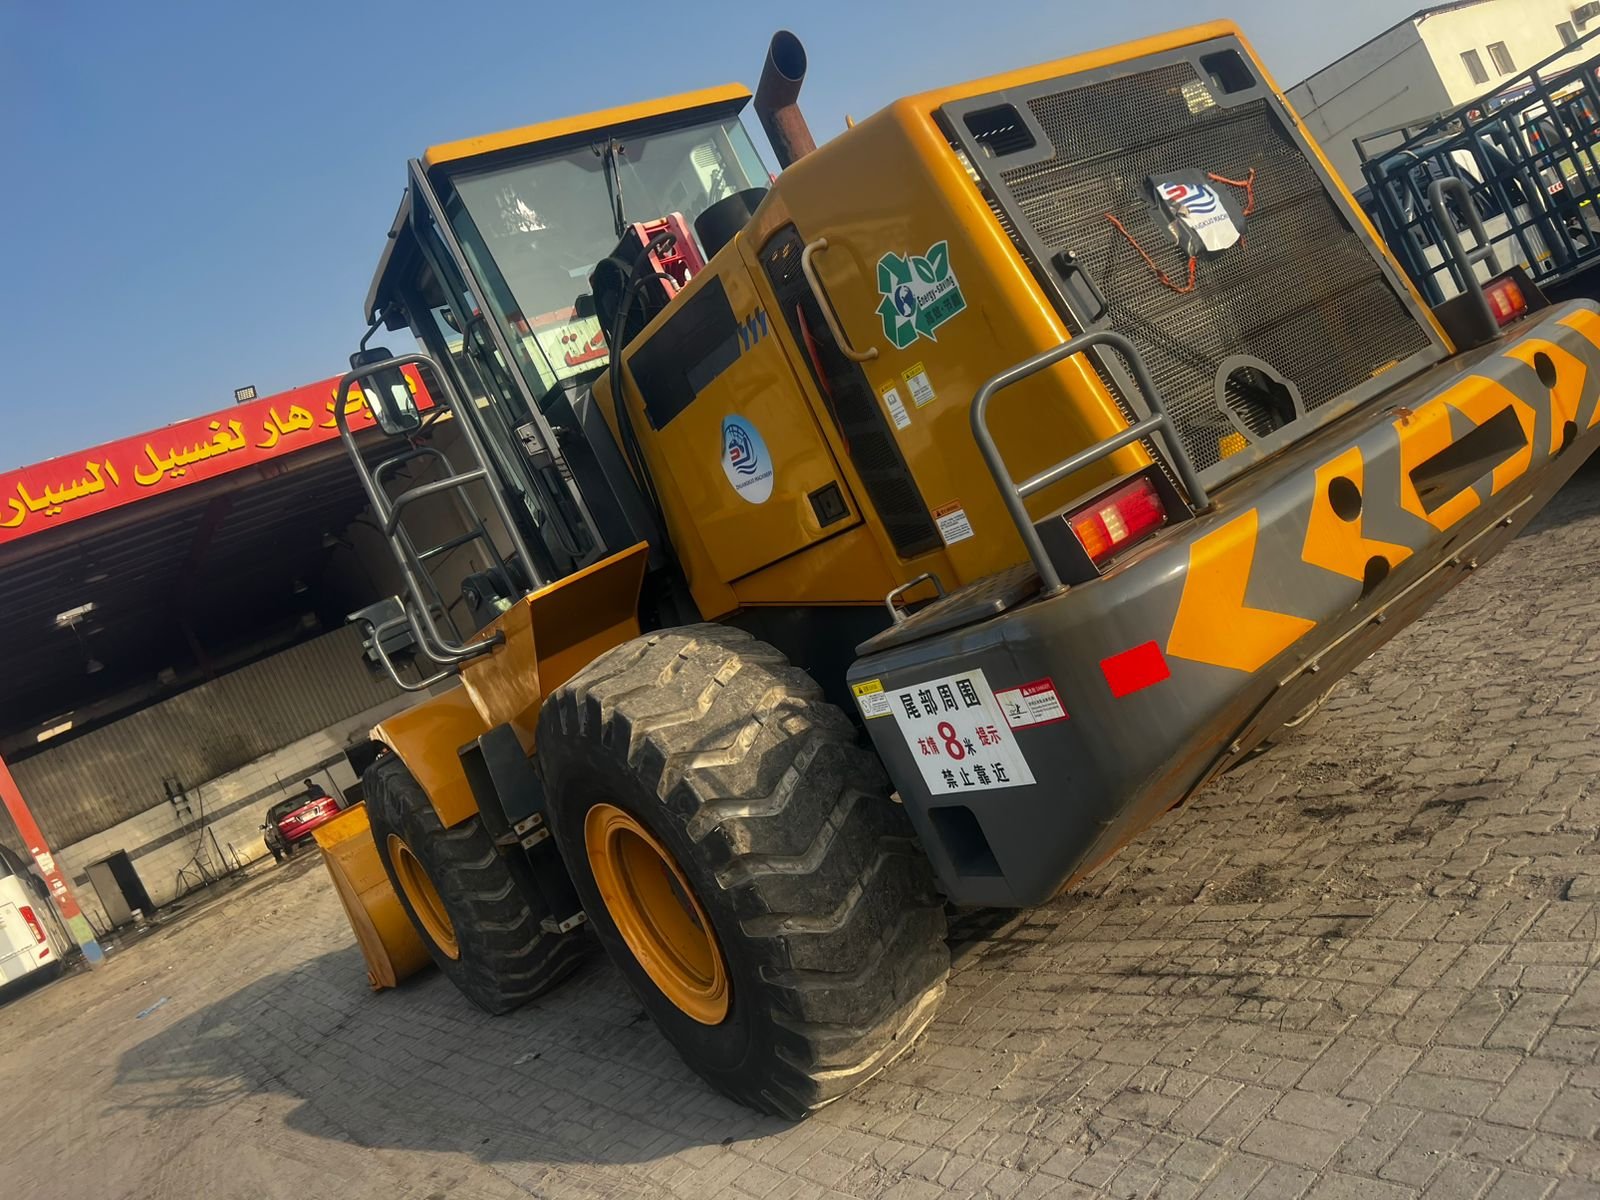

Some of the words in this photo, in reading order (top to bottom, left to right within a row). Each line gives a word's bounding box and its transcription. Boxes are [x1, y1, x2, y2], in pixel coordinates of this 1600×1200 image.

[133, 417, 246, 487] لغسيل
[0, 457, 121, 527] السيار
[899, 678, 982, 719] 尾部周围
[917, 735, 940, 756] 友情
[975, 725, 1002, 747] 提示
[941, 762, 1010, 789] 禁止靠近
